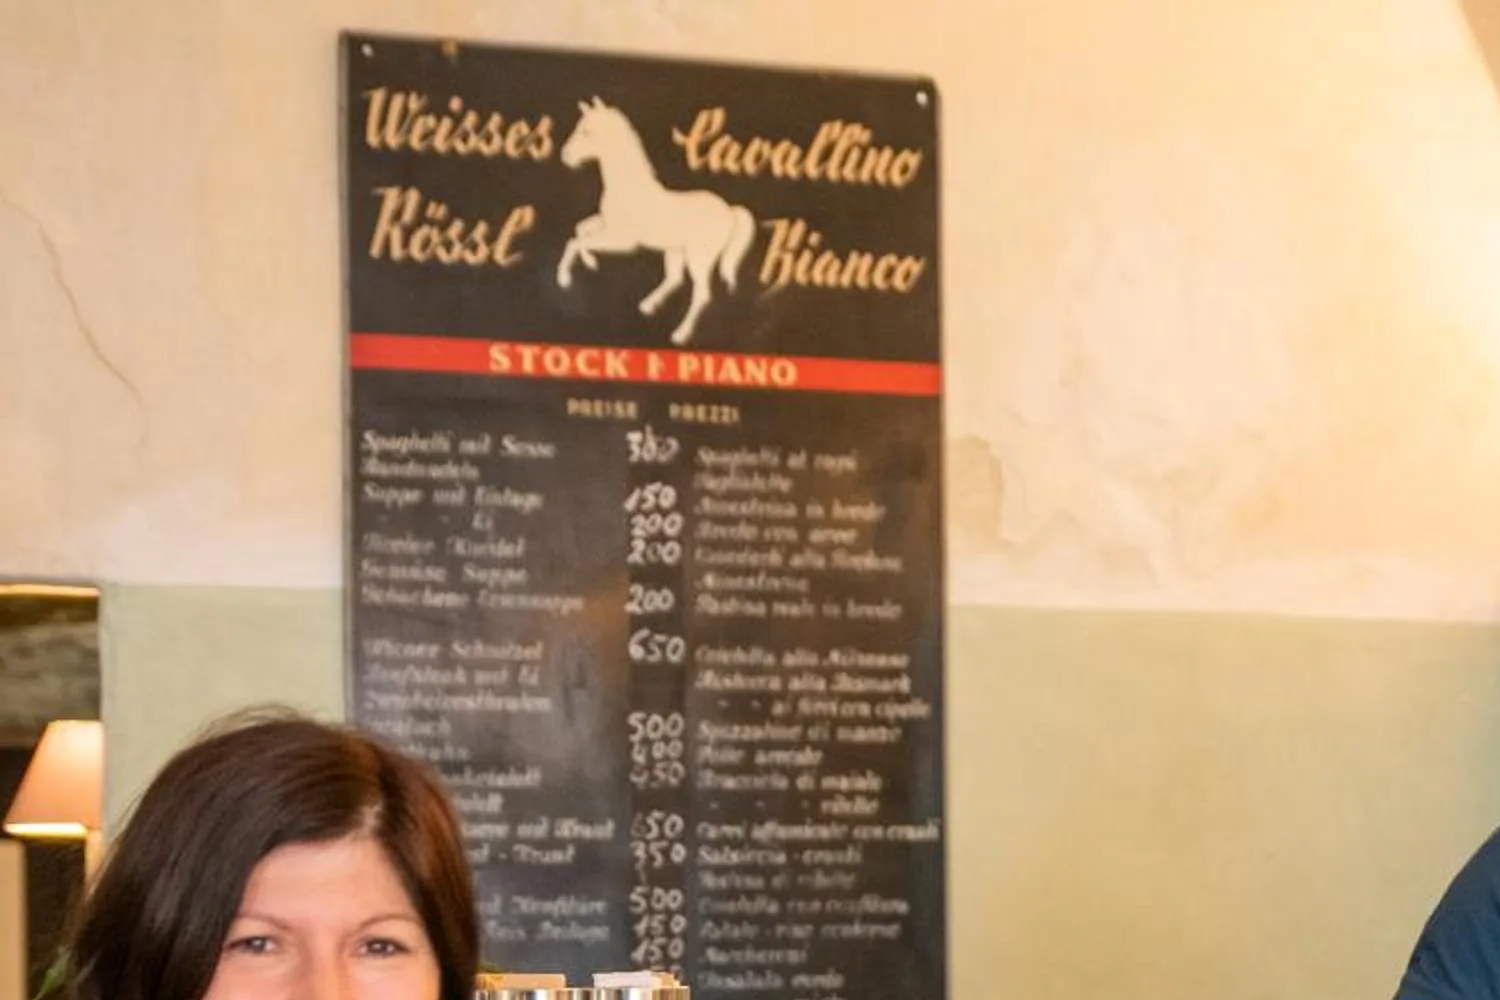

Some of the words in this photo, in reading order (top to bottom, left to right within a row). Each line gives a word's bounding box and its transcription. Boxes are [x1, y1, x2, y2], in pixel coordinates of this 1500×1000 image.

[363, 85, 554, 159] Weisses
[671, 106, 922, 188] Cavallino
[369, 185, 535, 267] Rössl
[760, 217, 925, 292] Bianco
[488, 343, 630, 379] STOCK
[677, 352, 798, 386] PIANO
[627, 629, 687, 664] 650
[627, 711, 685, 743] 500
